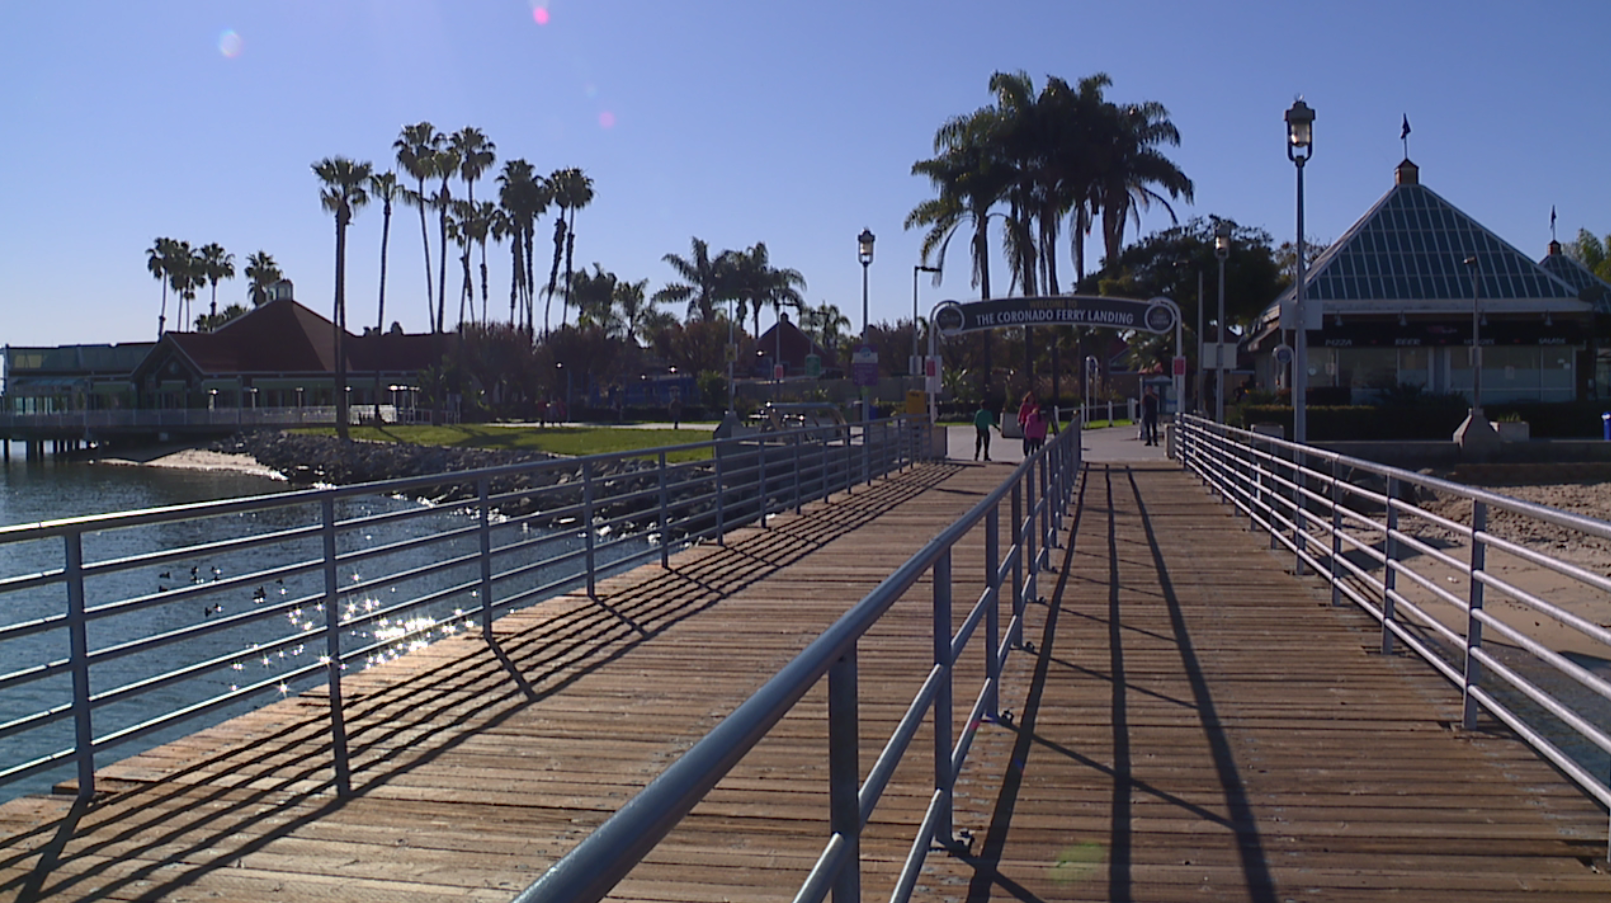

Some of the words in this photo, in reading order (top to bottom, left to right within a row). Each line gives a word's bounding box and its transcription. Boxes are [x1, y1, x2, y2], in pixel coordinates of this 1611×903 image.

[1029, 299, 1065, 309] WELCOME
[1067, 299, 1078, 308] TO
[975, 312, 995, 325] THE
[996, 309, 1055, 324] CORONADO
[1056, 309, 1086, 321] FERRY
[1087, 309, 1134, 325] LANDING
[1325, 338, 1352, 346] PIZZA
